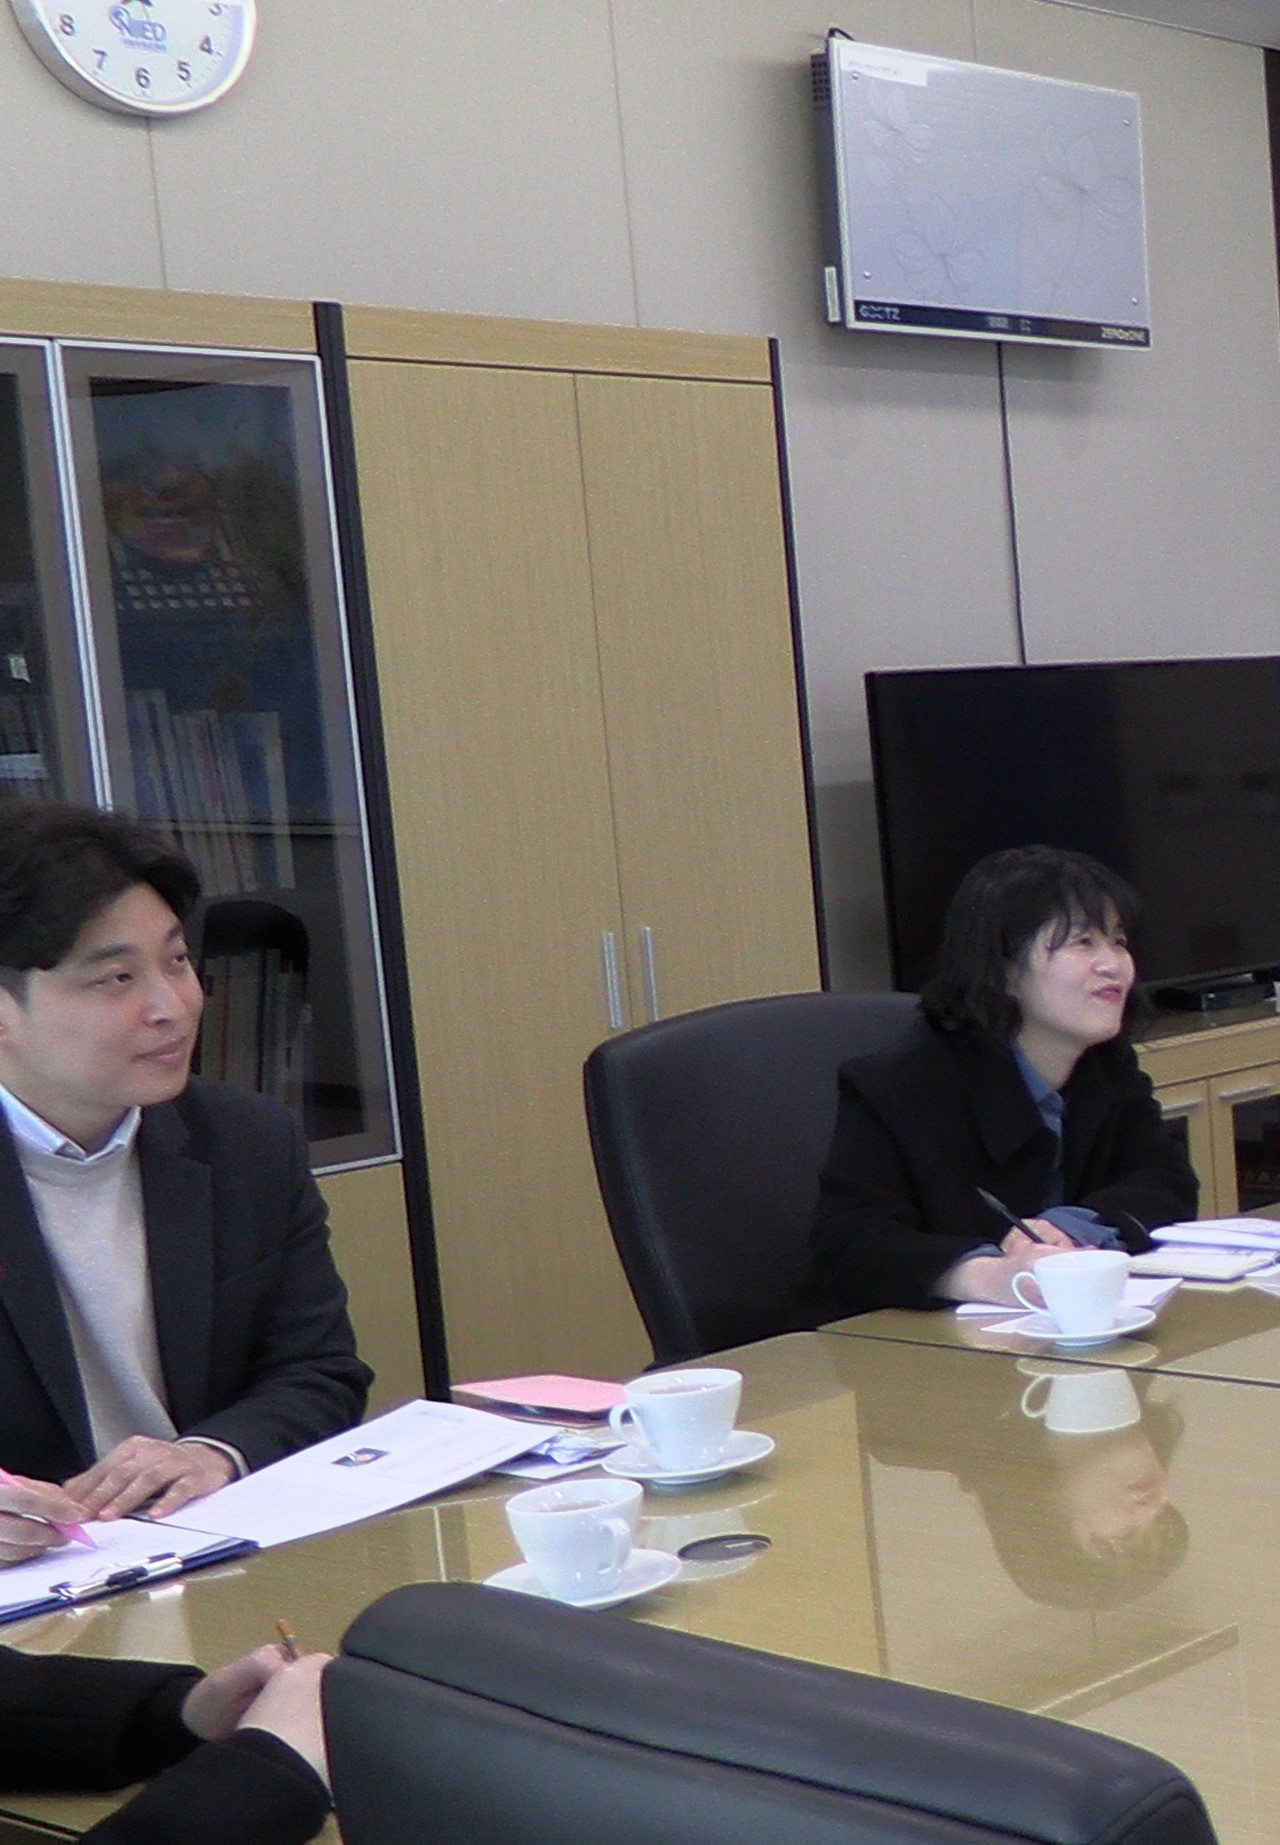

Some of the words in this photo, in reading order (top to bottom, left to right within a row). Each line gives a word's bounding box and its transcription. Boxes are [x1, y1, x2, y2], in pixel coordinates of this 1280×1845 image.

[59, 14, 75, 36] 8
[199, 35, 214, 55] 4
[92, 48, 108, 70] 7
[135, 67, 150, 88] 6
[177, 60, 191, 81] 5
